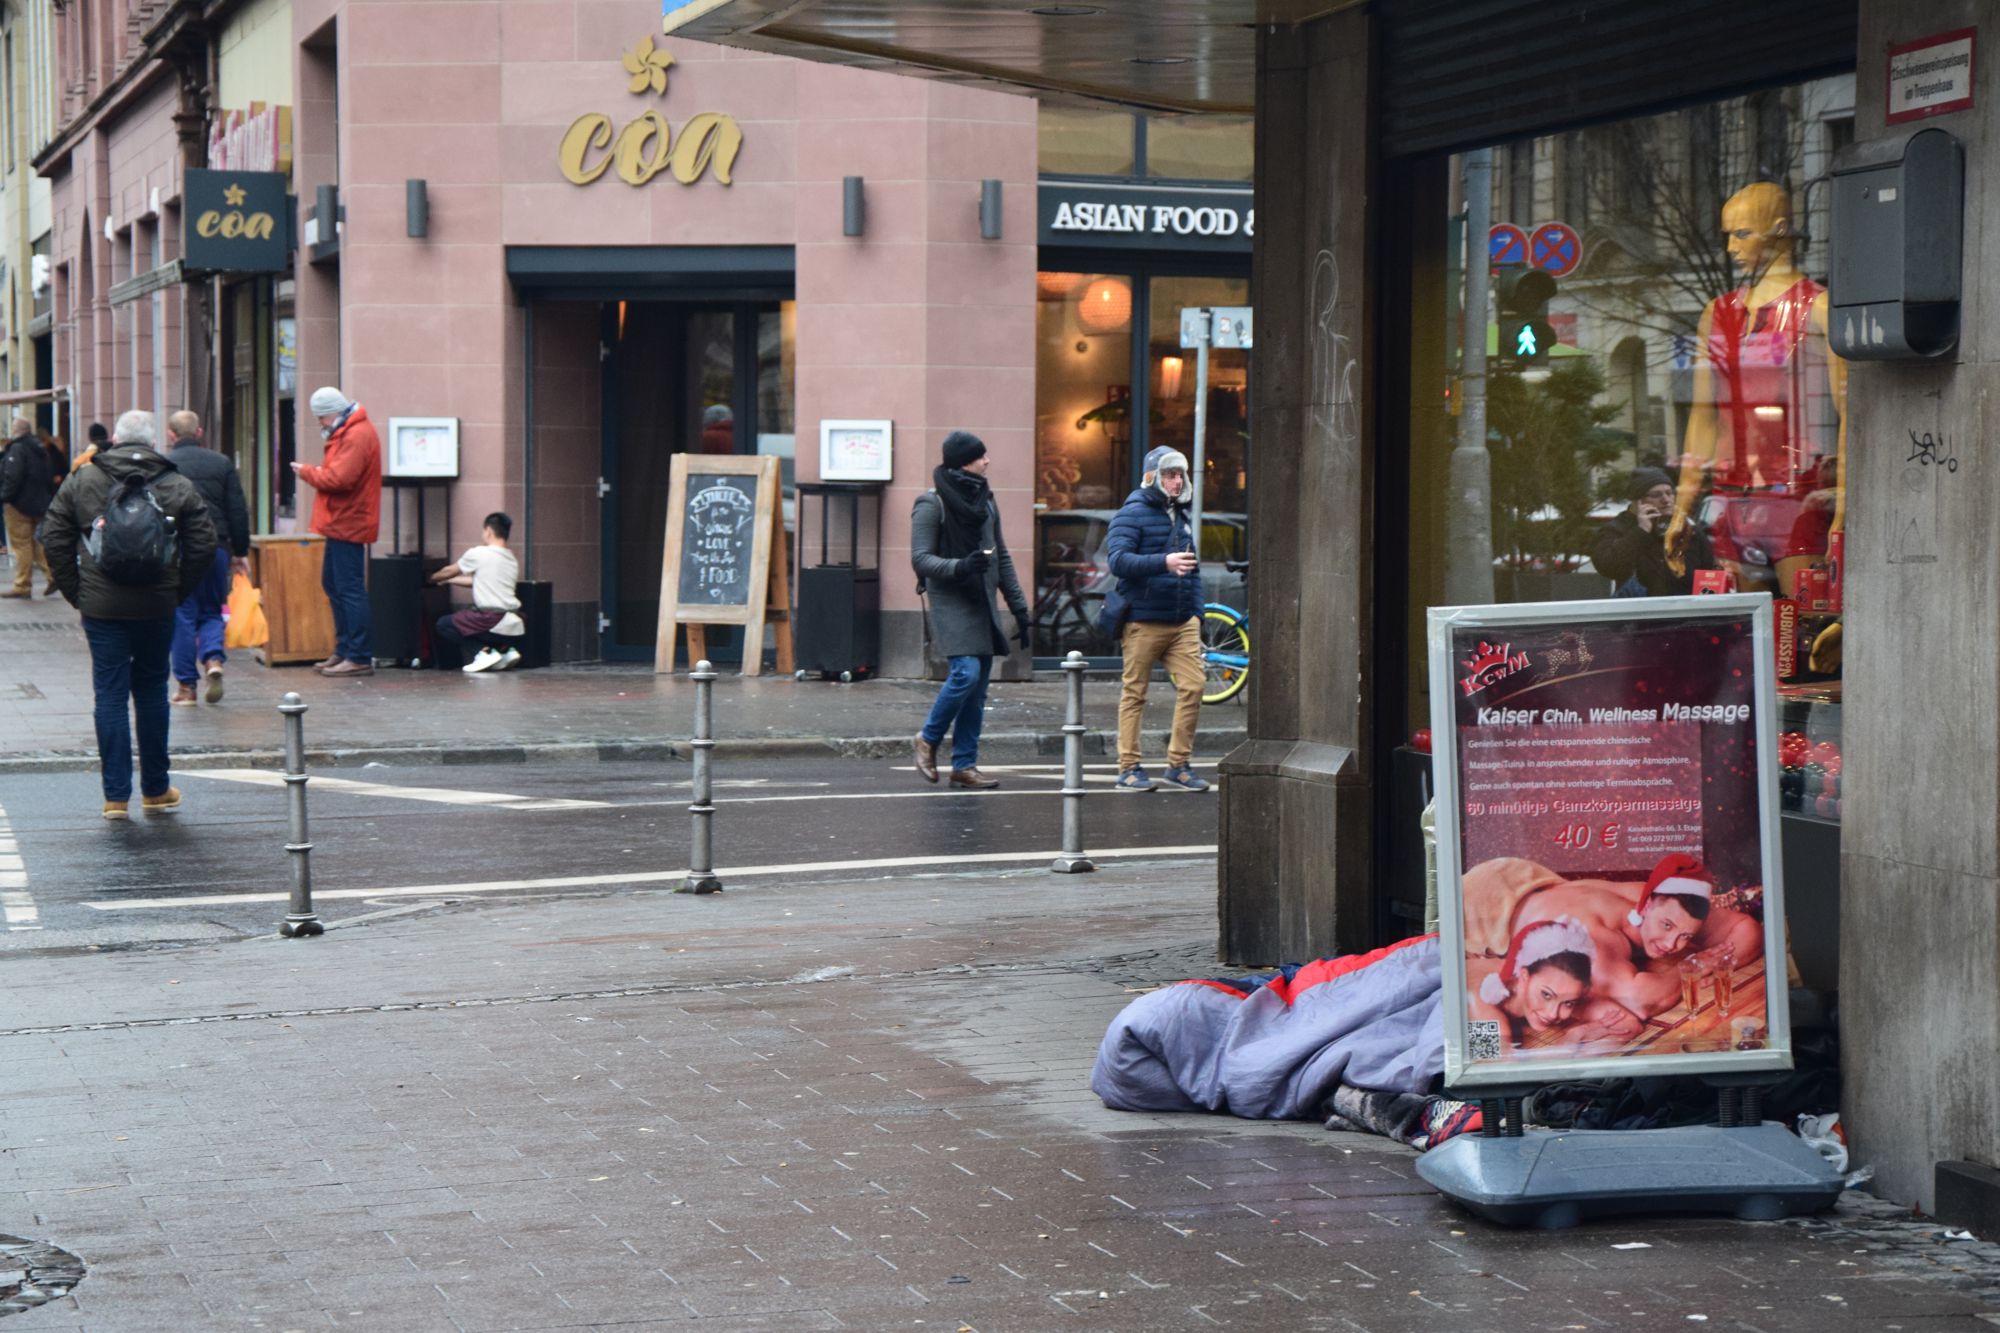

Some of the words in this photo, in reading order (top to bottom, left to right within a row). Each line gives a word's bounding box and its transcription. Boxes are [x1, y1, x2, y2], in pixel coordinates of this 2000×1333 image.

[559, 109, 743, 187] coa
[196, 210, 275, 240] coa
[1050, 202, 1147, 232] ASIAN
[1151, 206, 1239, 235] FOOD
[1477, 707, 1539, 725] Kaiser
[1542, 708, 1583, 724] Chin.
[1589, 706, 1657, 722] Wellness
[1662, 702, 1750, 724] Massage
[1518, 738, 1531, 747] die
[1532, 738, 1549, 746] eine
[1550, 736, 1606, 748] entspannende
[1607, 735, 1652, 744] chinesische
[1527, 759, 1535, 767] in
[1536, 757, 1595, 768] ansprechender
[1596, 756, 1611, 765] und
[1612, 756, 1641, 767] ruhiger
[1493, 780, 1512, 790] auch
[1512, 779, 1544, 790] spontan
[1545, 778, 1565, 788] ohne
[1567, 777, 1605, 789] vorherige
[1552, 799, 1701, 815] Ganzkörpermassage
[1554, 823, 1592, 849] 40
[1600, 822, 1620, 848] €
